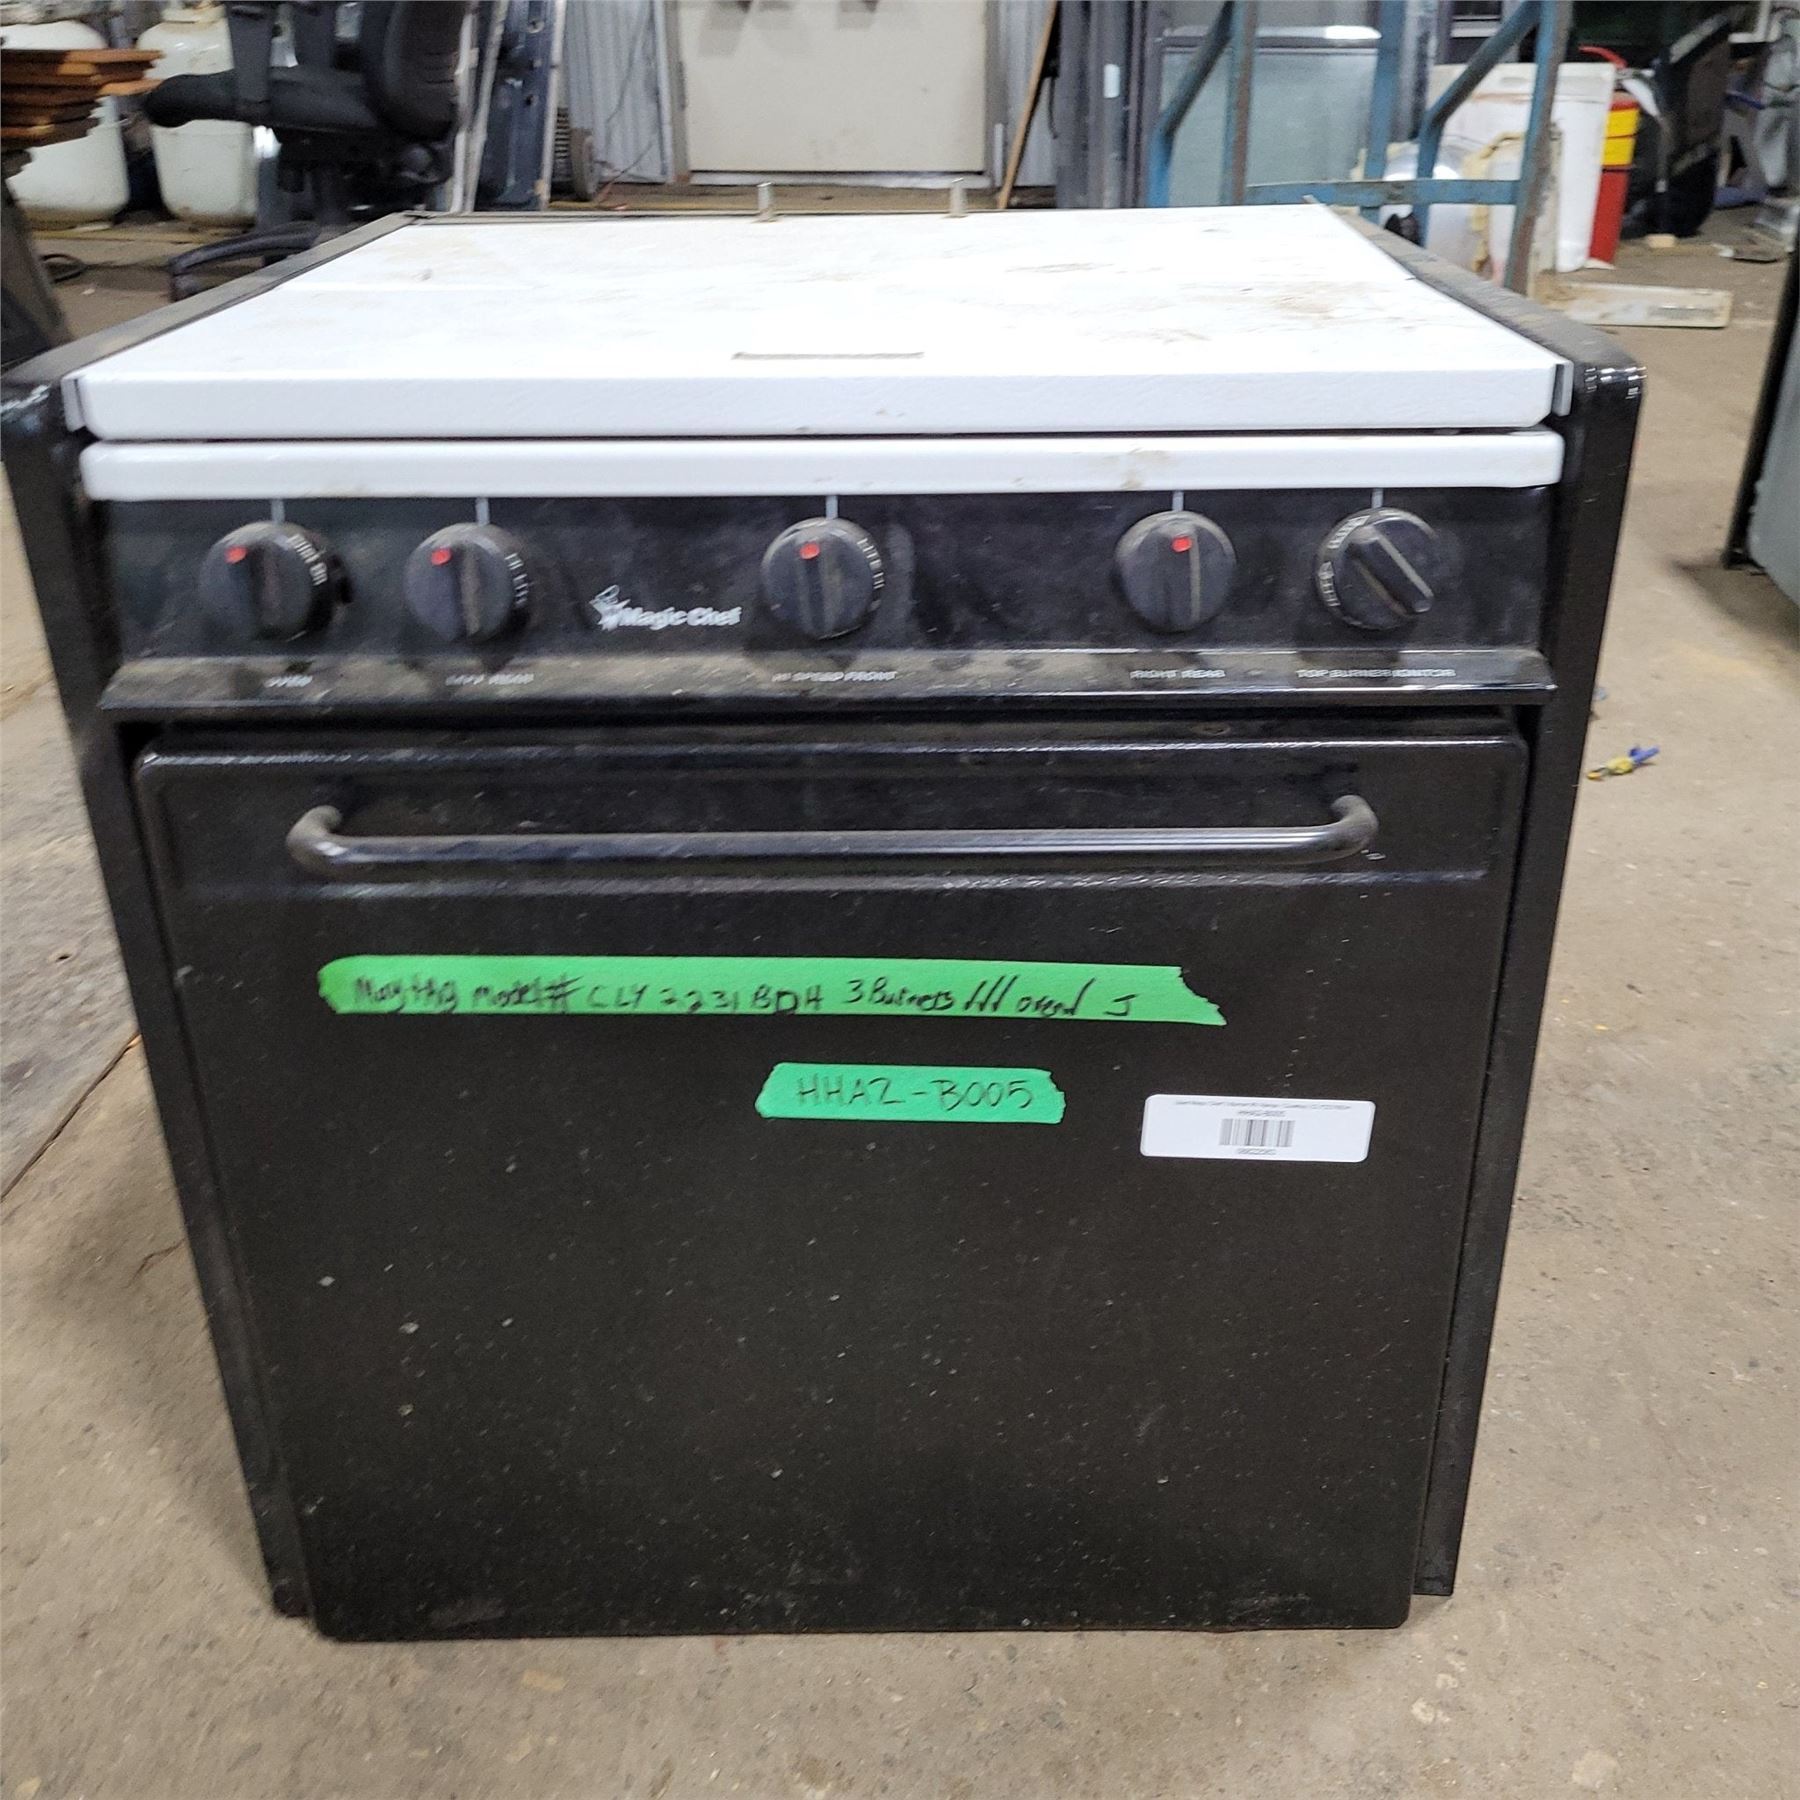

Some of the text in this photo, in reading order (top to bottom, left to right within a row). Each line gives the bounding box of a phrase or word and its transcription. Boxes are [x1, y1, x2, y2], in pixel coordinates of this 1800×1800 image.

[617, 606, 742, 631] Magic Chef
[844, 671, 898, 682] FRONT
[1130, 669, 1226, 680] RIGHT REAR
[1297, 669, 1329, 678] TOP
[1328, 669, 1392, 678] BURNER
